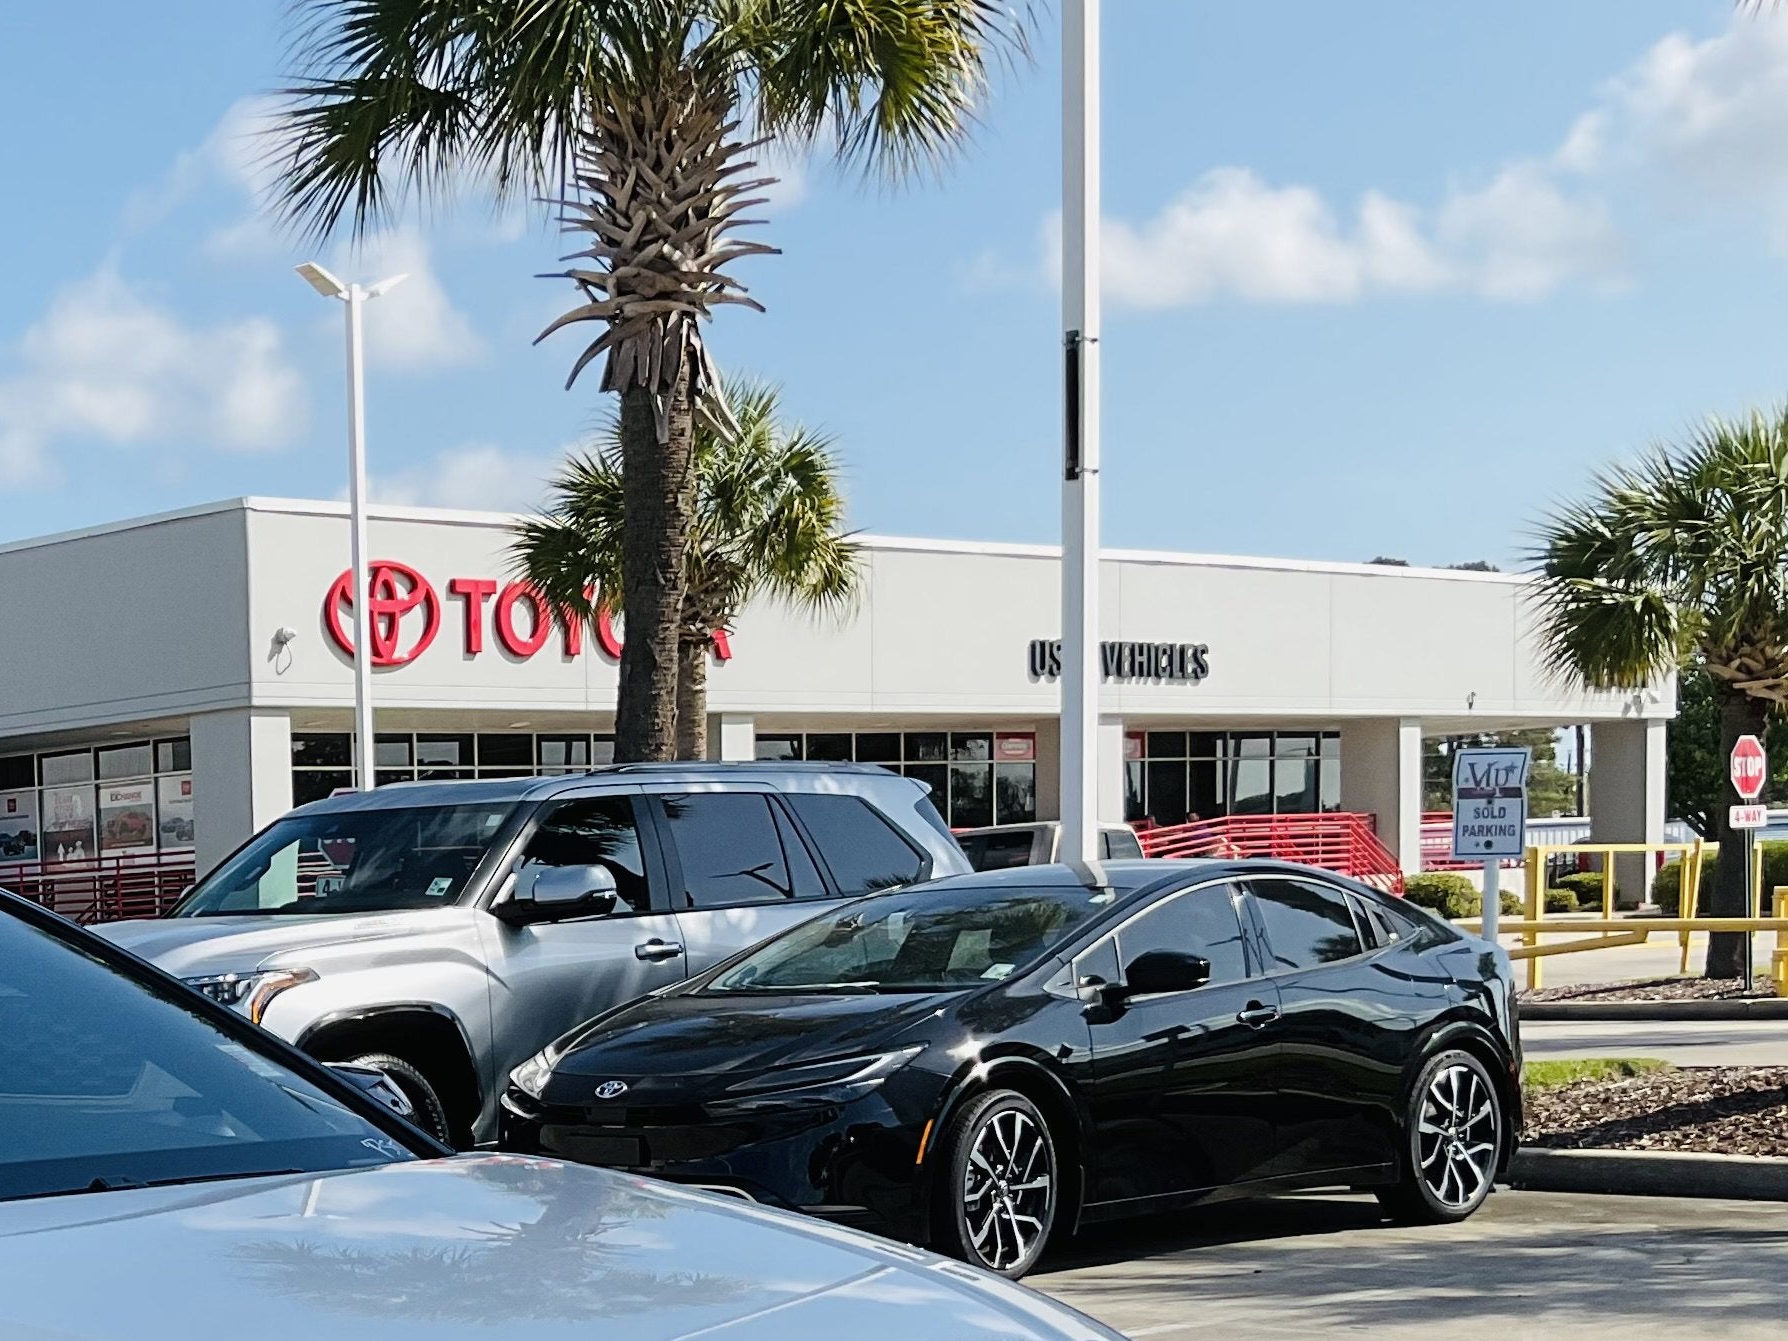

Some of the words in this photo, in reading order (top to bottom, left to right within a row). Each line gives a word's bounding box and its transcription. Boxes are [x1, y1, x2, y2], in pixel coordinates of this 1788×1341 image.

[1100, 641, 1209, 680] VEHICLES
[1733, 756, 1762, 777] STOP
[1473, 806, 1506, 819] SOLD
[1734, 810, 1762, 822] 4-WAY
[1462, 824, 1516, 837] PARKING
